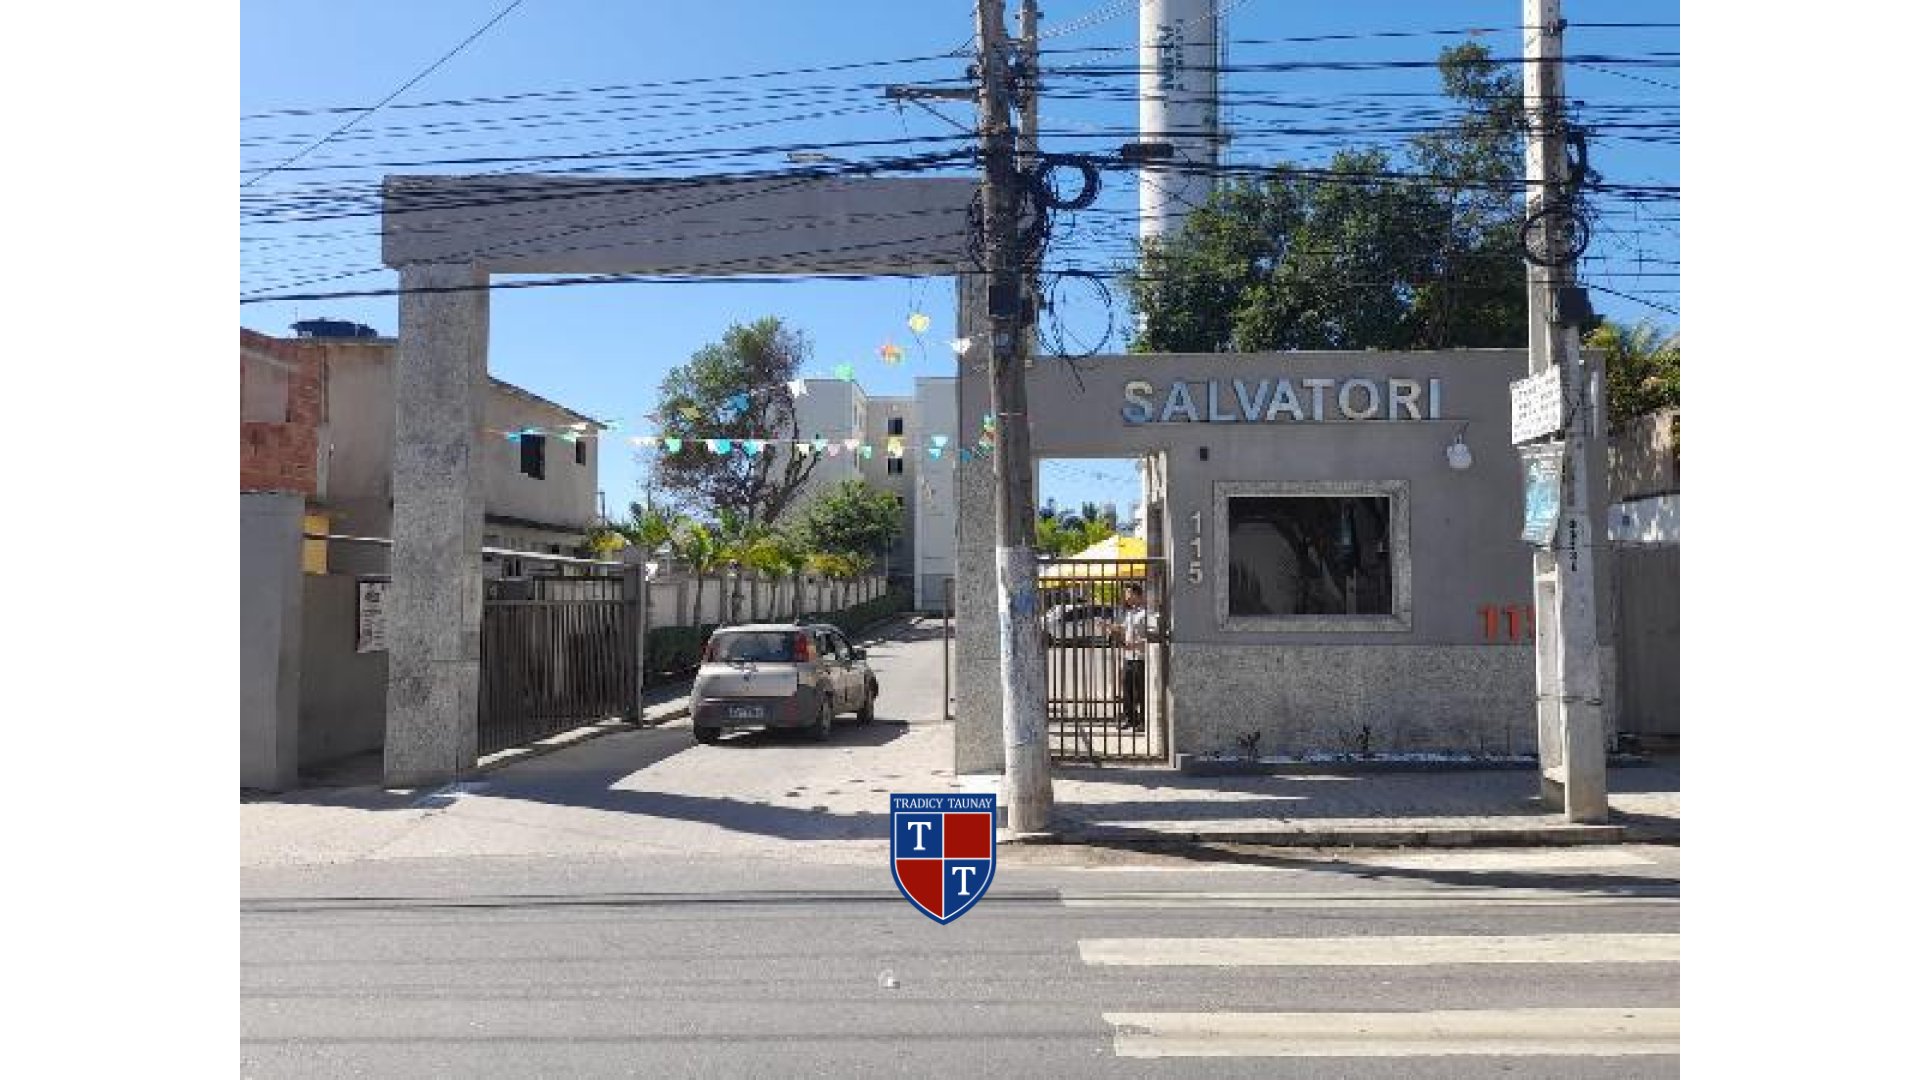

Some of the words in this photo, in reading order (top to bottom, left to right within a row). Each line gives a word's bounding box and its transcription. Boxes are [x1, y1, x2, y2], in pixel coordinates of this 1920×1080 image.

[1123, 377, 1442, 424] SALVATORI
[1188, 510, 1203, 584] 115
[1477, 604, 1536, 642] 11
